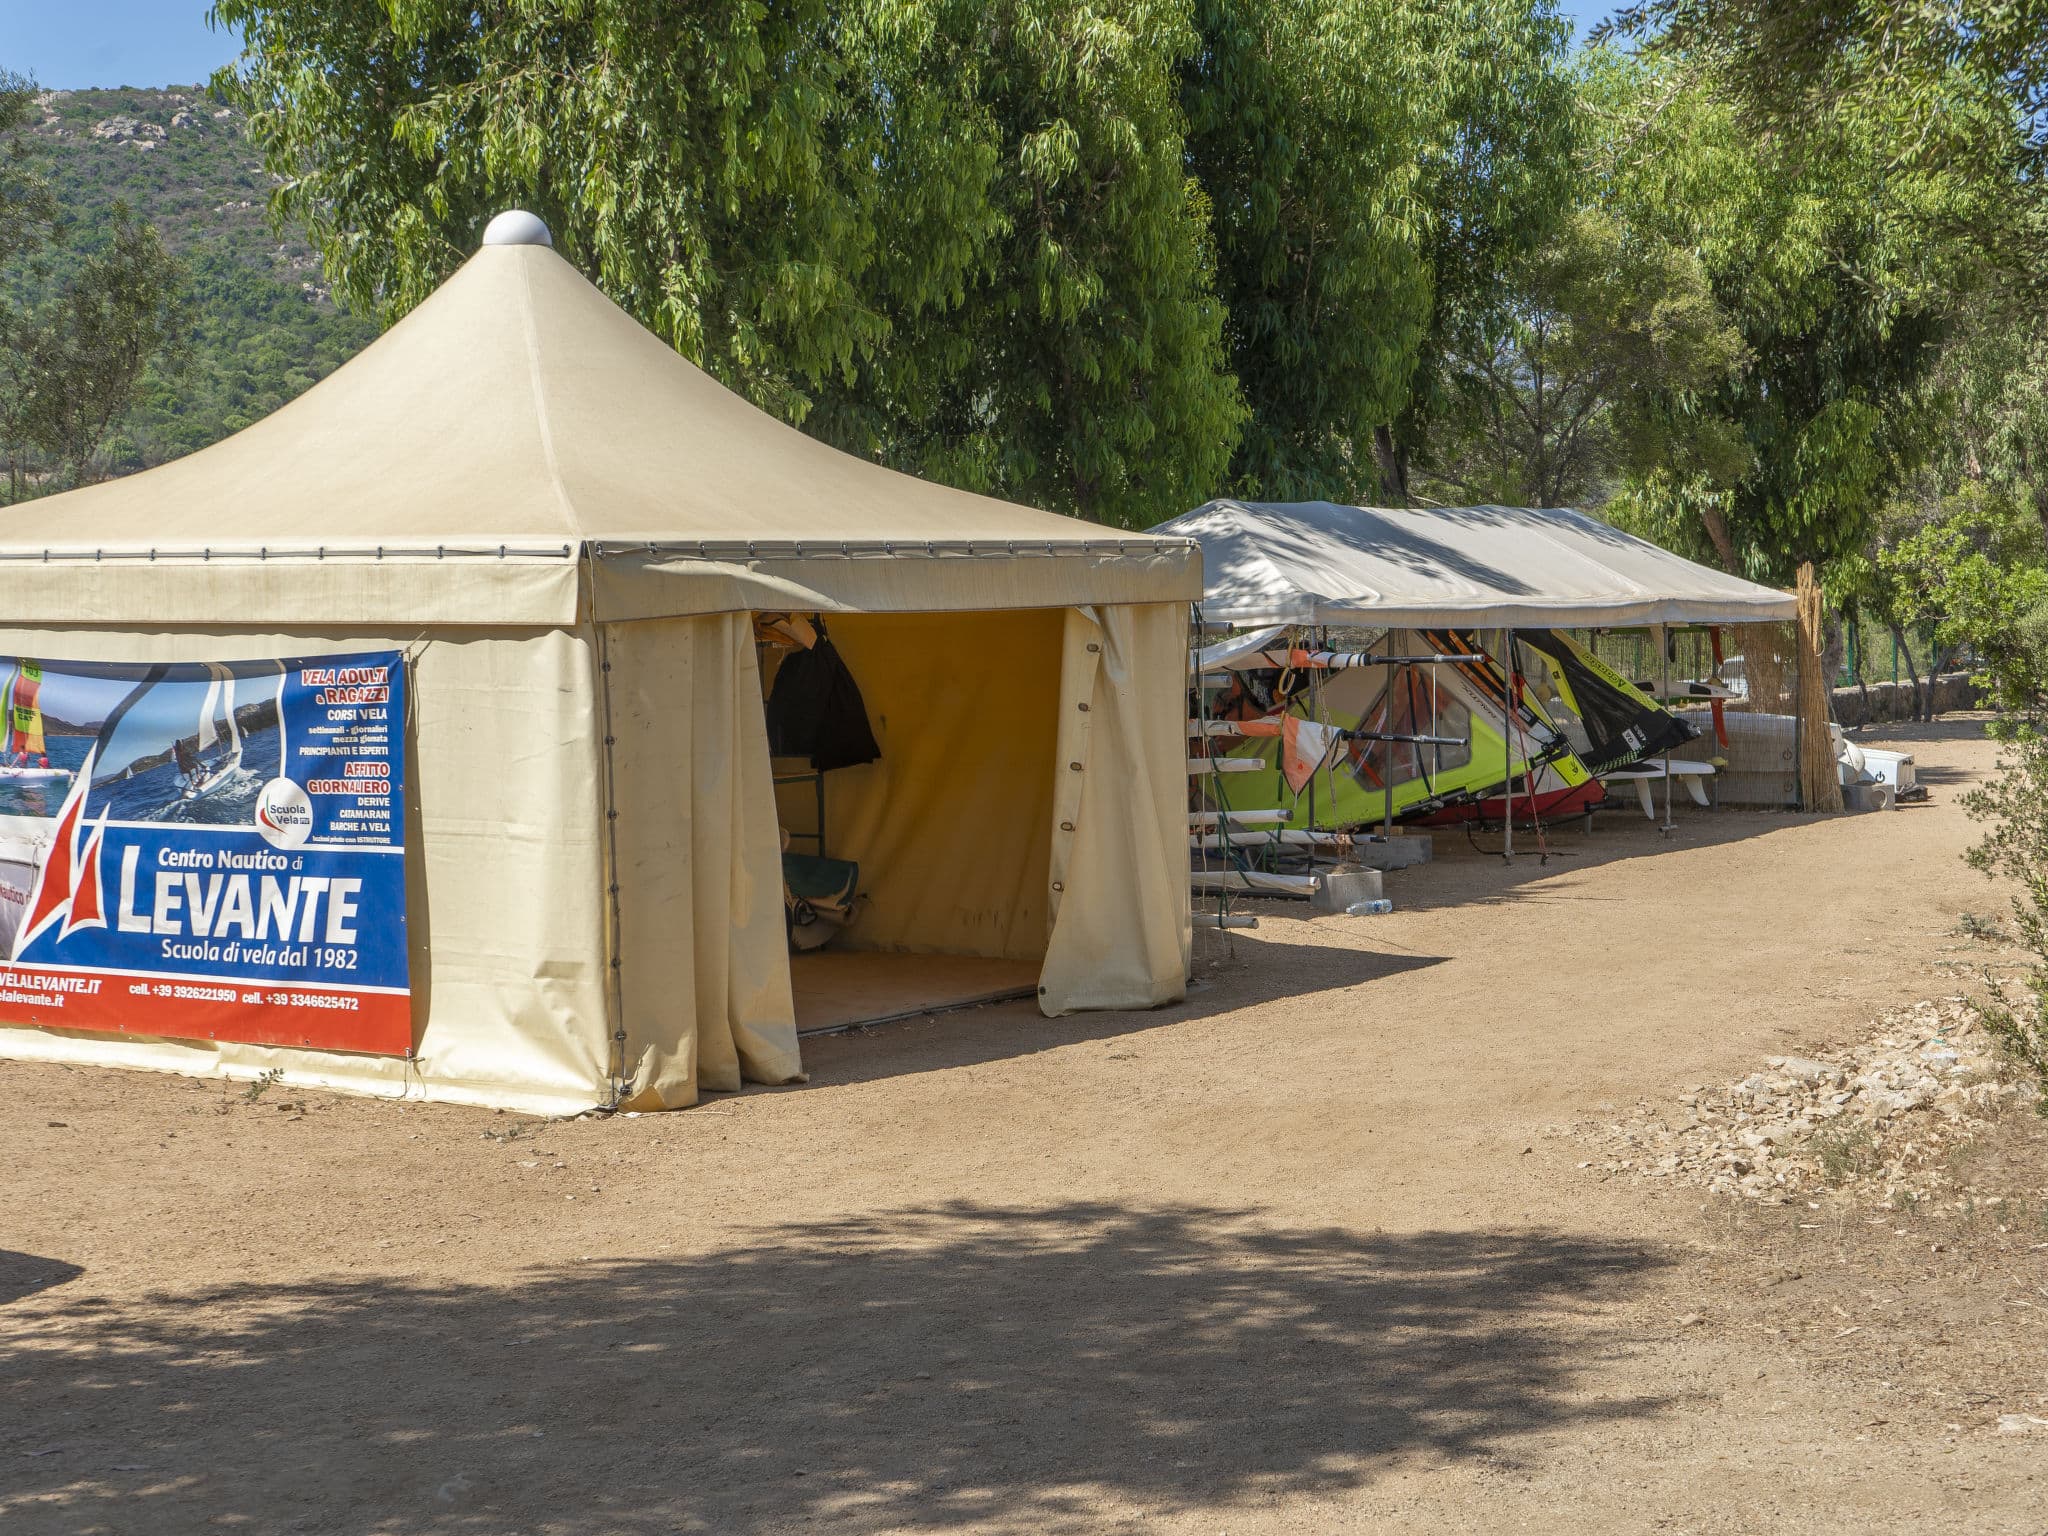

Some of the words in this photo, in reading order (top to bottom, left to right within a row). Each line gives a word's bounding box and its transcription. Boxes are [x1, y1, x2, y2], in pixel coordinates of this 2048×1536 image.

[301, 669, 334, 686] VELA
[338, 666, 389, 686] ADULTI
[325, 686, 389, 704] RAGAZZI
[327, 709, 357, 721] CORSI
[359, 708, 388, 721] VELA
[299, 746, 350, 756] PRINCIPIANTI
[351, 747, 358, 756] E
[359, 746, 389, 755] ESPERTI
[344, 762, 390, 777] AFFITTO
[307, 780, 390, 795] GIORNALIERO
[357, 797, 390, 807] DERIVE
[271, 805, 305, 815] Scuola
[339, 809, 390, 820] CATAMARANI
[275, 815, 299, 825] Vela
[330, 821, 359, 832] BARCHE
[361, 822, 368, 831] A
[368, 822, 390, 832] VELA
[158, 847, 214, 868] Centro
[218, 849, 288, 870] Nautico
[292, 856, 303, 871] di
[117, 845, 363, 945] LEVANTE
[162, 940, 219, 961] Scuola
[223, 941, 241, 963] di
[242, 944, 277, 964] vela
[279, 945, 308, 967] dal
[314, 947, 358, 969] 1982
[129, 982, 150, 996] cell.
[152, 985, 172, 997] +39
[173, 986, 237, 1002] 3926221950
[242, 993, 264, 1005] cell.
[265, 993, 289, 1007] +39
[290, 993, 359, 1010] 3346625472
